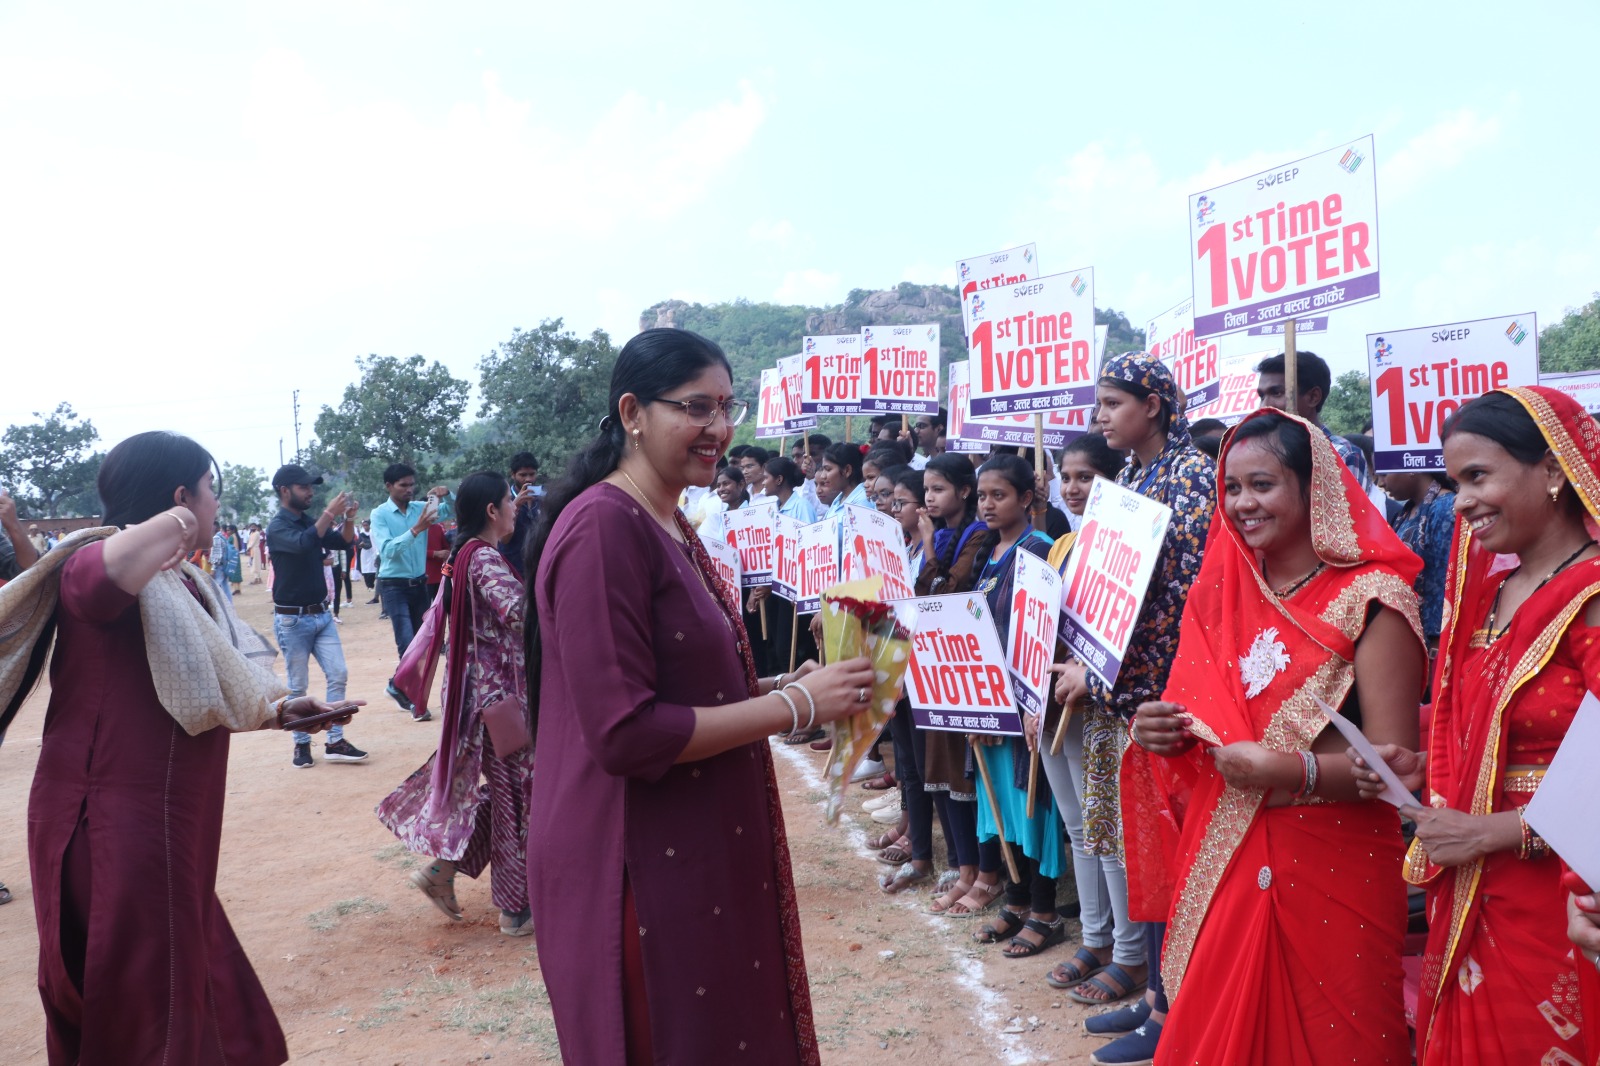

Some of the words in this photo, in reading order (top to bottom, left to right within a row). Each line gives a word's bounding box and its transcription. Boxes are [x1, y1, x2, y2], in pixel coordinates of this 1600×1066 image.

[1256, 167, 1300, 191] SWEEP
[1256, 193, 1342, 246] Time
[1230, 221, 1371, 301] VOTER
[1013, 283, 1044, 298] SWEEP
[1224, 311, 1248, 329] जिला
[1257, 303, 1282, 321] उत्तर
[1284, 297, 1311, 315] बस्तर
[1313, 286, 1346, 308] कांकेर
[1013, 310, 1073, 346] Time
[1431, 328, 1470, 343] SWEEP
[835, 352, 862, 374] Tim
[892, 345, 928, 369] Time
[995, 340, 1090, 391] VOTER
[822, 375, 860, 400] VOT
[879, 370, 936, 398] VOTER
[1431, 358, 1508, 397] Time
[990, 399, 1008, 413] जिला
[1022, 432, 1036, 443] बस्त
[1403, 452, 1426, 468] जिला
[745, 525, 771, 546] Time
[739, 544, 774, 572] VOTE
[813, 542, 833, 566] Time
[875, 540, 905, 582] Time
[1101, 529, 1142, 588] Time
[807, 563, 837, 596] VOTER
[917, 601, 943, 613] SWEEP
[1076, 565, 1137, 652] VOTER
[926, 627, 983, 662] Time
[921, 664, 1012, 707] VOTER
